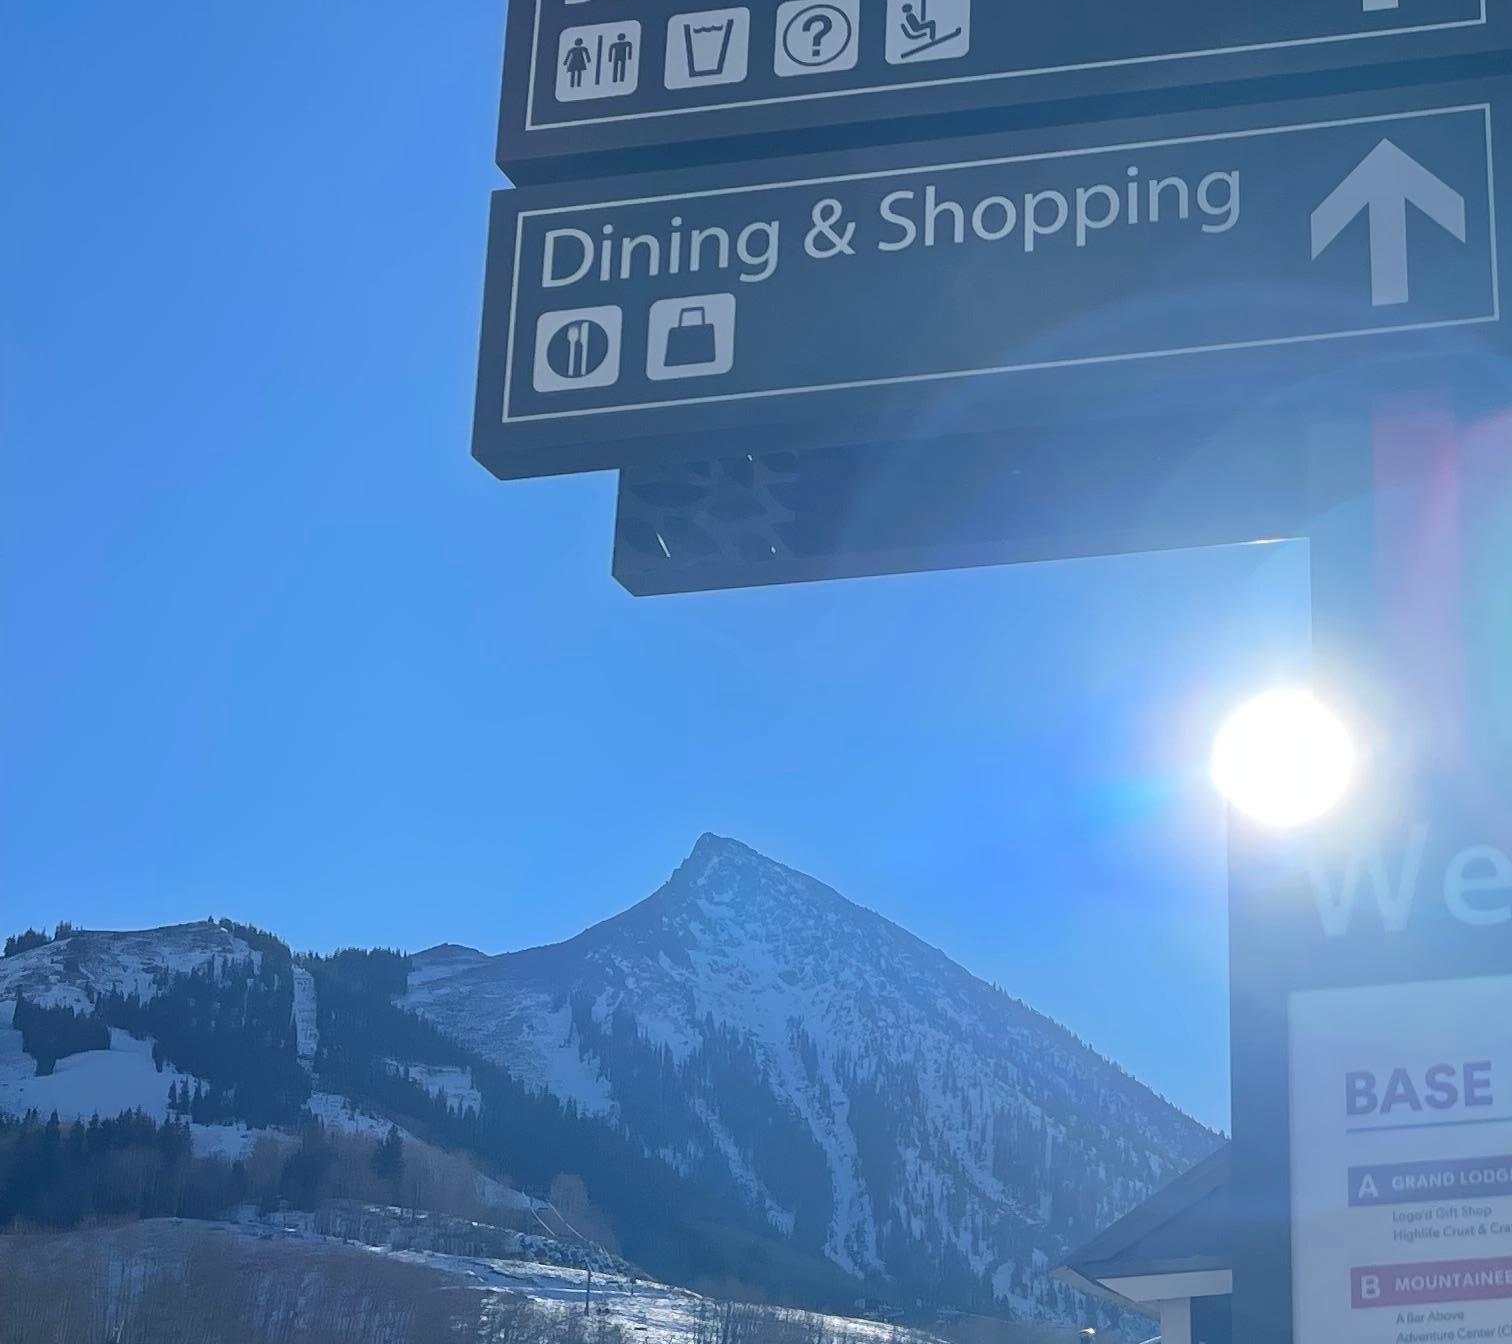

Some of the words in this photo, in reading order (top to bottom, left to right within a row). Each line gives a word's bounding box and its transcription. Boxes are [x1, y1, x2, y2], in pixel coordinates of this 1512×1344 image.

[541, 214, 780, 288] Dining
[804, 203, 856, 255] &
[879, 168, 1242, 253] Shopping
[1345, 1060, 1493, 1117] BASE
[1357, 1173, 1378, 1199] A
[1391, 1171, 1455, 1191] GRAND
[1361, 1274, 1380, 1299] B
